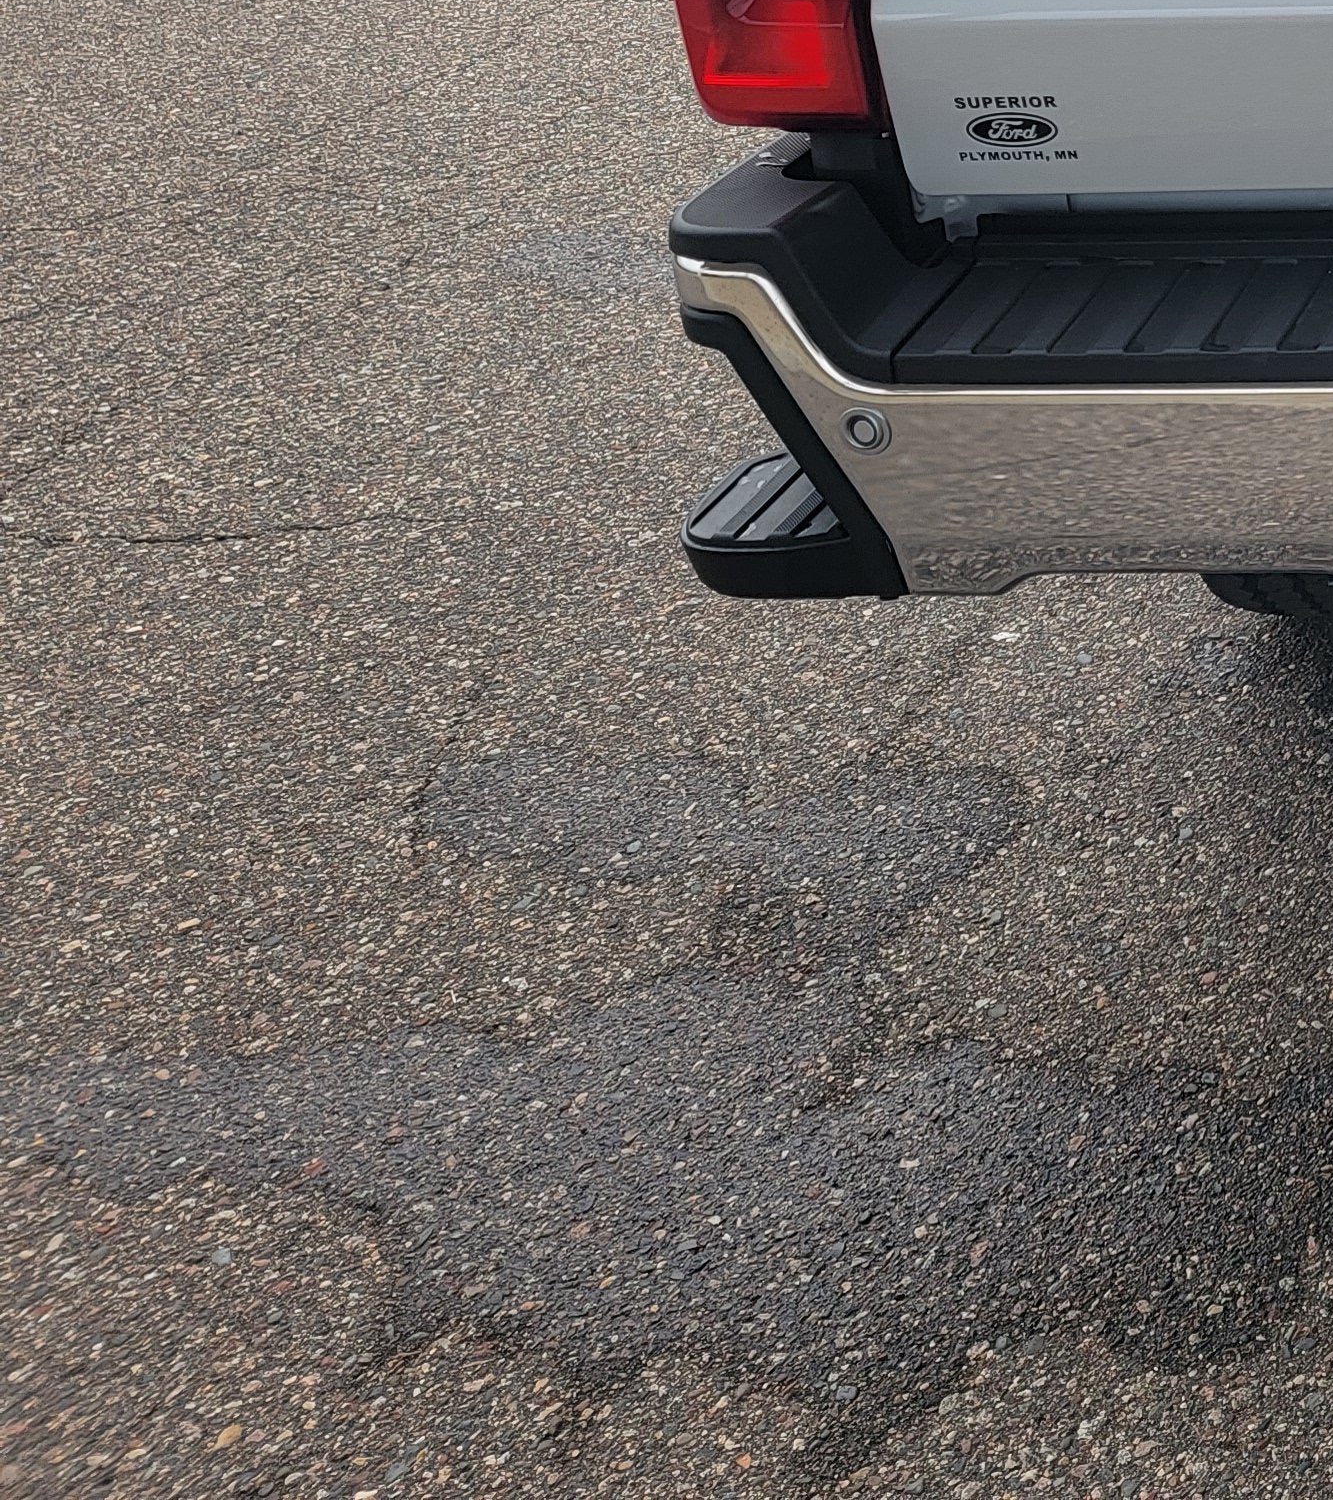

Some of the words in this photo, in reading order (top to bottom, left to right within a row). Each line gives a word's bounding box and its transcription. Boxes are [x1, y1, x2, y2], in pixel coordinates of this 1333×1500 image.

[953, 96, 1058, 110] SUPERIOR
[987, 119, 1038, 140] Ford
[958, 150, 1050, 162] PLYMOUTH,
[1054, 150, 1079, 160] MN
